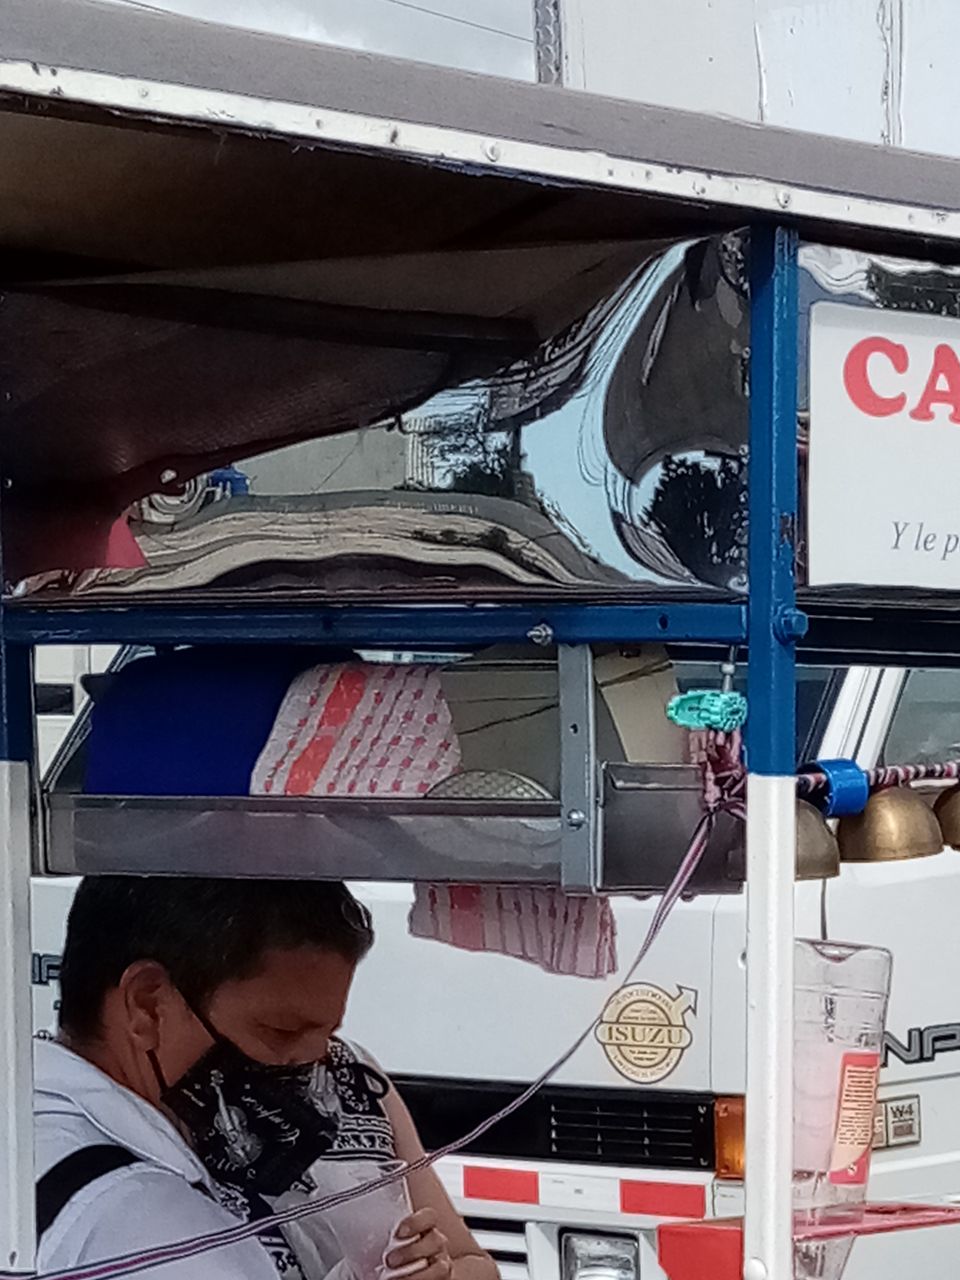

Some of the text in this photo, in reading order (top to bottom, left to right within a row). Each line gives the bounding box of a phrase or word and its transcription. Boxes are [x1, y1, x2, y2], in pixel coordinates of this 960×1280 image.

[891, 521, 911, 550] Y
[914, 522, 937, 551] le
[607, 1026, 682, 1044] ISUZU
